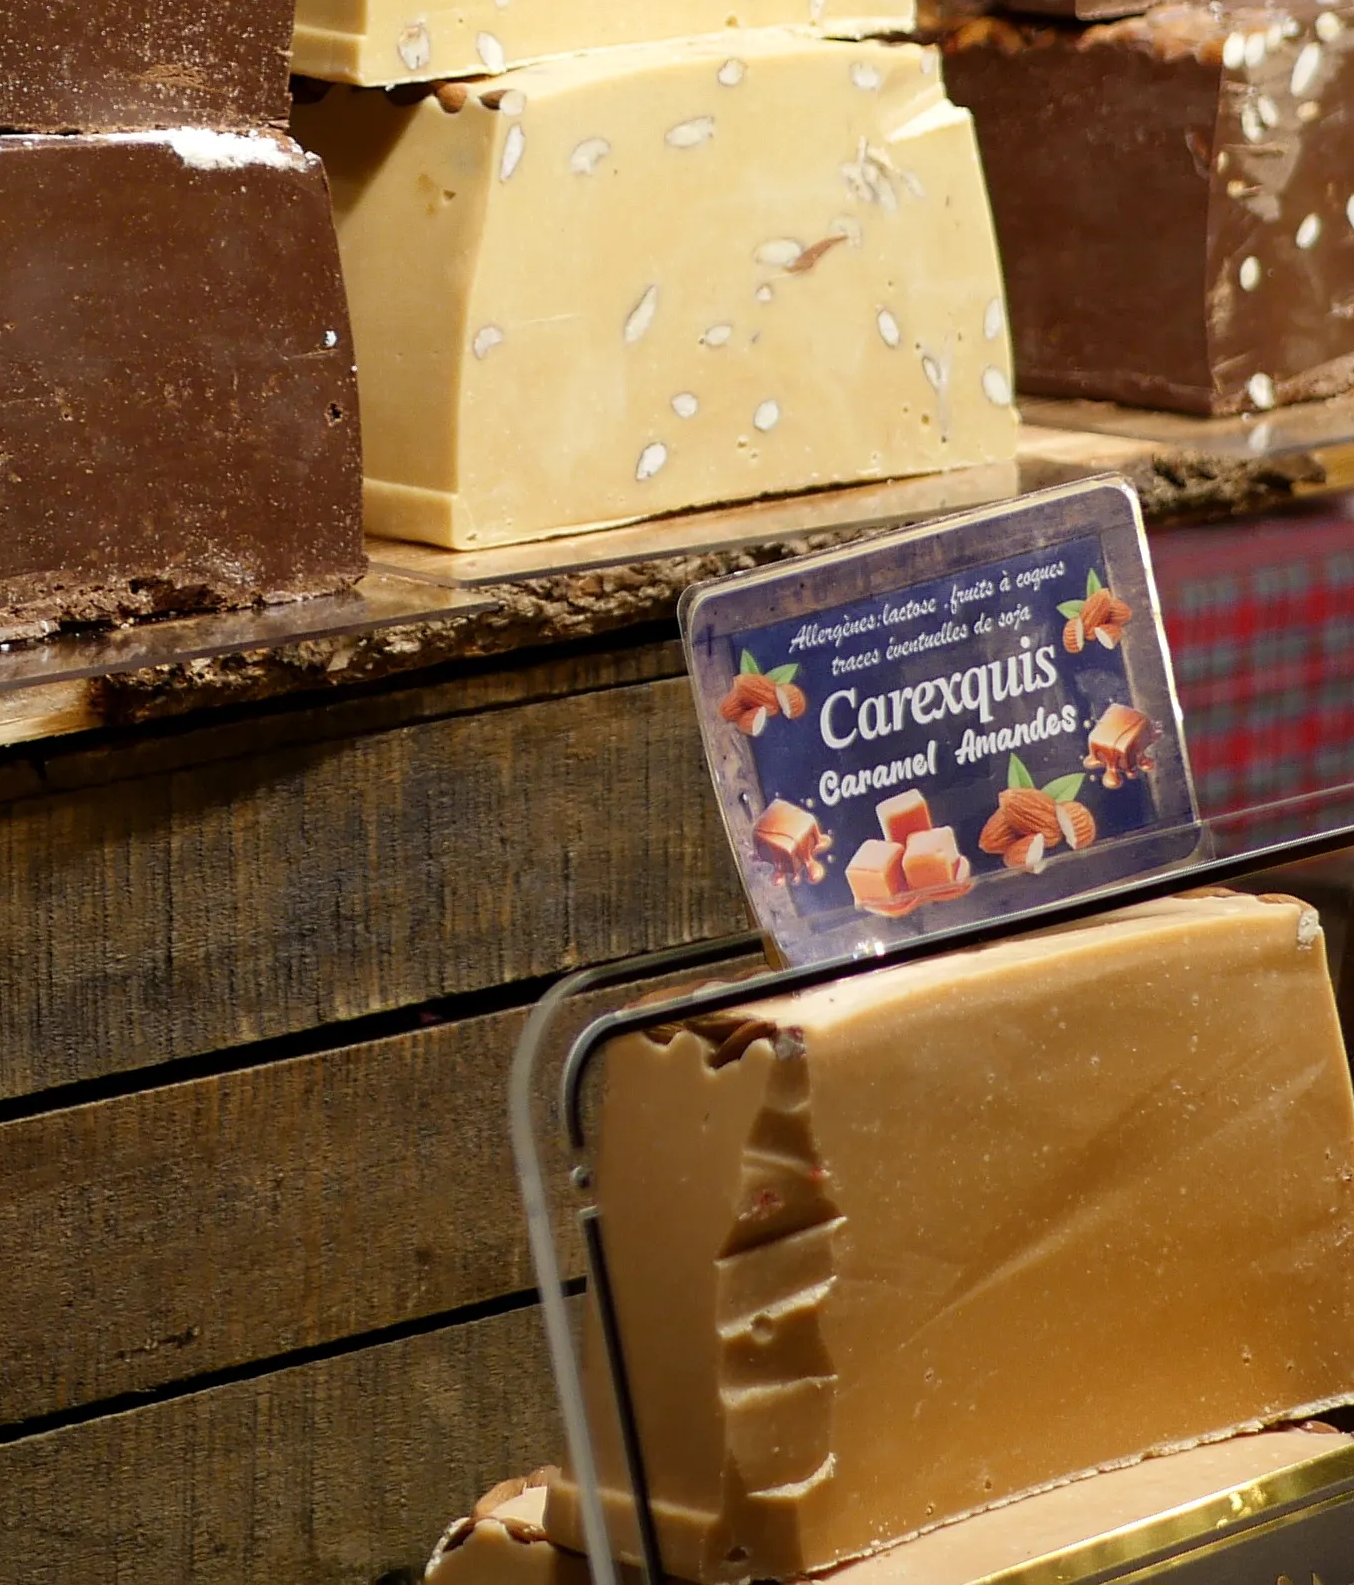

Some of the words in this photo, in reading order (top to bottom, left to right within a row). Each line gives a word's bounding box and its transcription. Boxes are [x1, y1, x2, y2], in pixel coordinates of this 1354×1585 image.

[999, 570, 1012, 592] à
[1016, 560, 1066, 592] coques
[831, 648, 881, 676] traces
[885, 622, 969, 660] éventuelles
[973, 613, 993, 634] de
[998, 604, 1032, 631] soja
[820, 636, 1058, 750] Carexquis
[819, 739, 938, 807] Caramel
[954, 704, 1078, 765] Amandes
